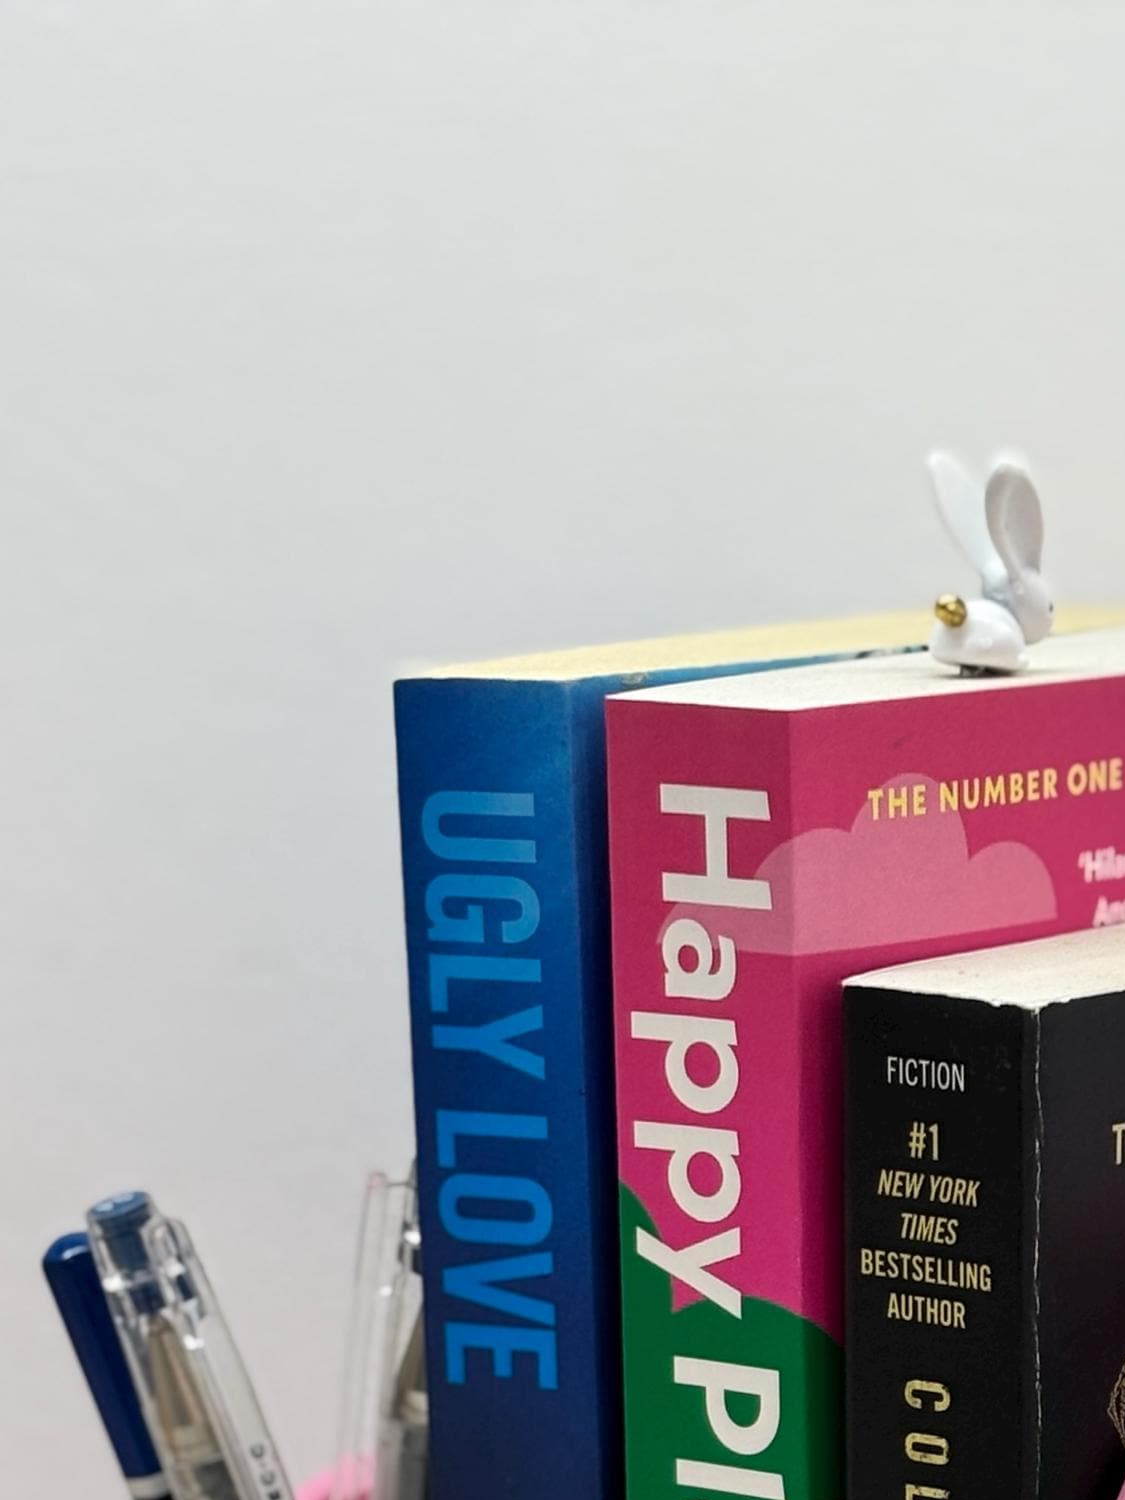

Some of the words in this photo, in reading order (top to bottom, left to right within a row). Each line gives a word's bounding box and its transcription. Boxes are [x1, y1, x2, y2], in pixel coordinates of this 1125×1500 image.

[868, 785, 926, 820] THE
[939, 768, 1058, 813] NUMBER
[1067, 757, 1123, 796] ONE
[421, 789, 546, 1081] UGLY
[630, 783, 773, 1320] Happy
[886, 1056, 965, 1092] FICTION
[908, 1121, 940, 1161] #1
[877, 1168, 924, 1199] NEW
[928, 1174, 981, 1208] YORK
[436, 1108, 559, 1391] LOVE
[900, 1212, 959, 1246] TIMES
[860, 1248, 992, 1293] BESTSELLING
[887, 1292, 966, 1329] AUTHOR
